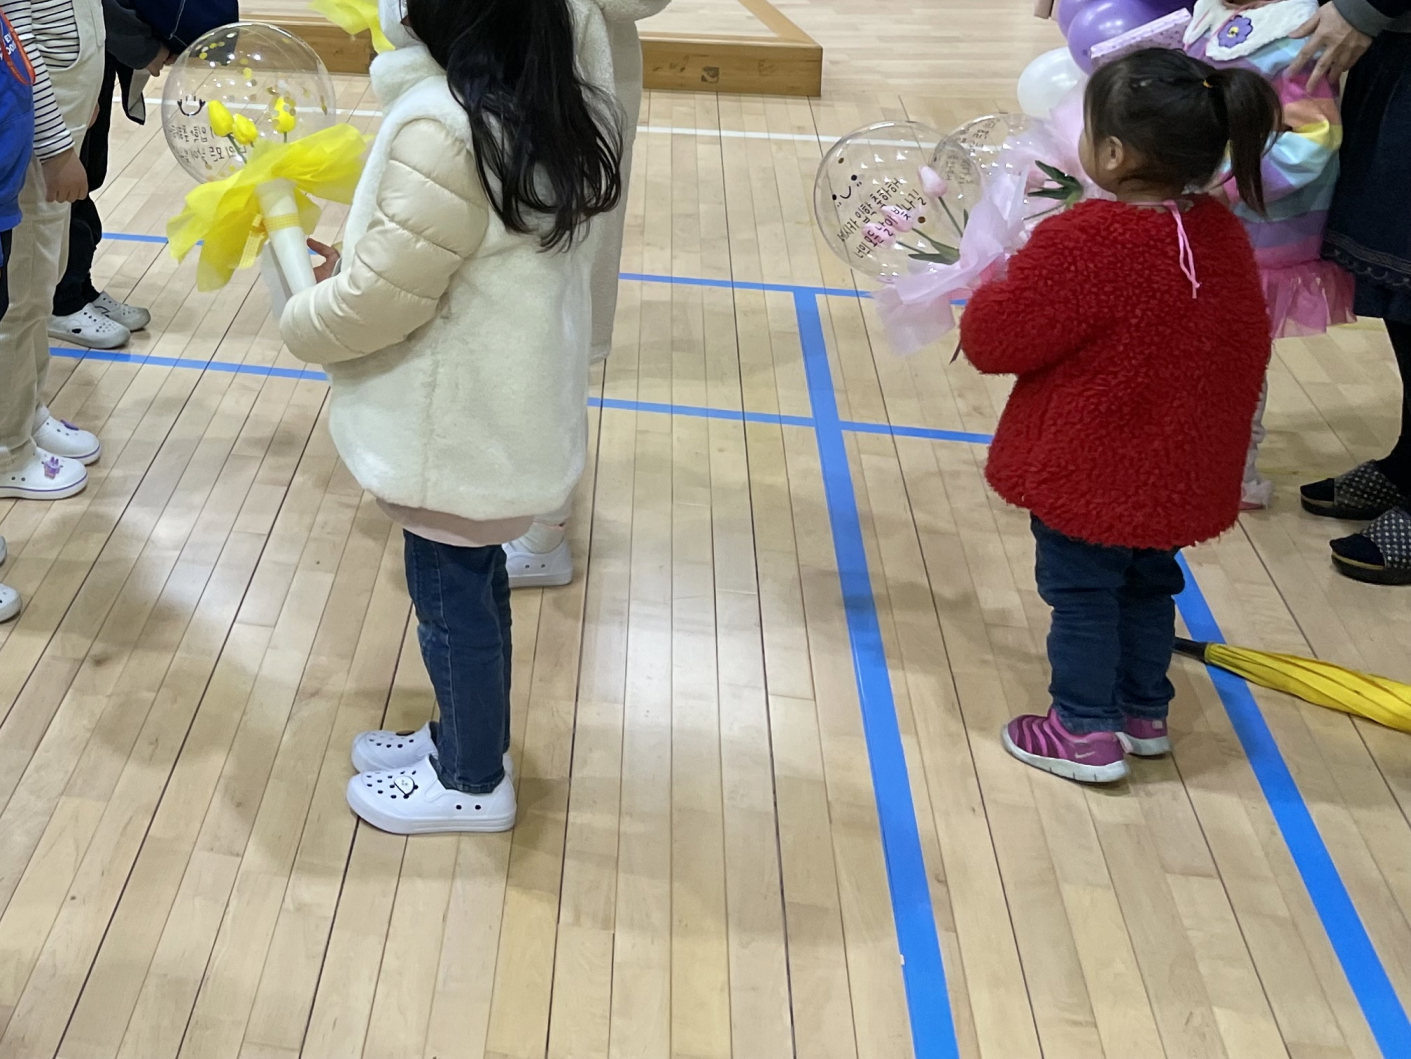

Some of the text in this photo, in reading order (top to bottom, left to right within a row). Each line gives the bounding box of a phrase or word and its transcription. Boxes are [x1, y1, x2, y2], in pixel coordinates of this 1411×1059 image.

[854, 202, 877, 224] 입학
[869, 177, 903, 209] 축하해
[864, 230, 885, 248] 모든
[875, 215, 899, 237] 날이
[891, 188, 927, 221] 빛나길
